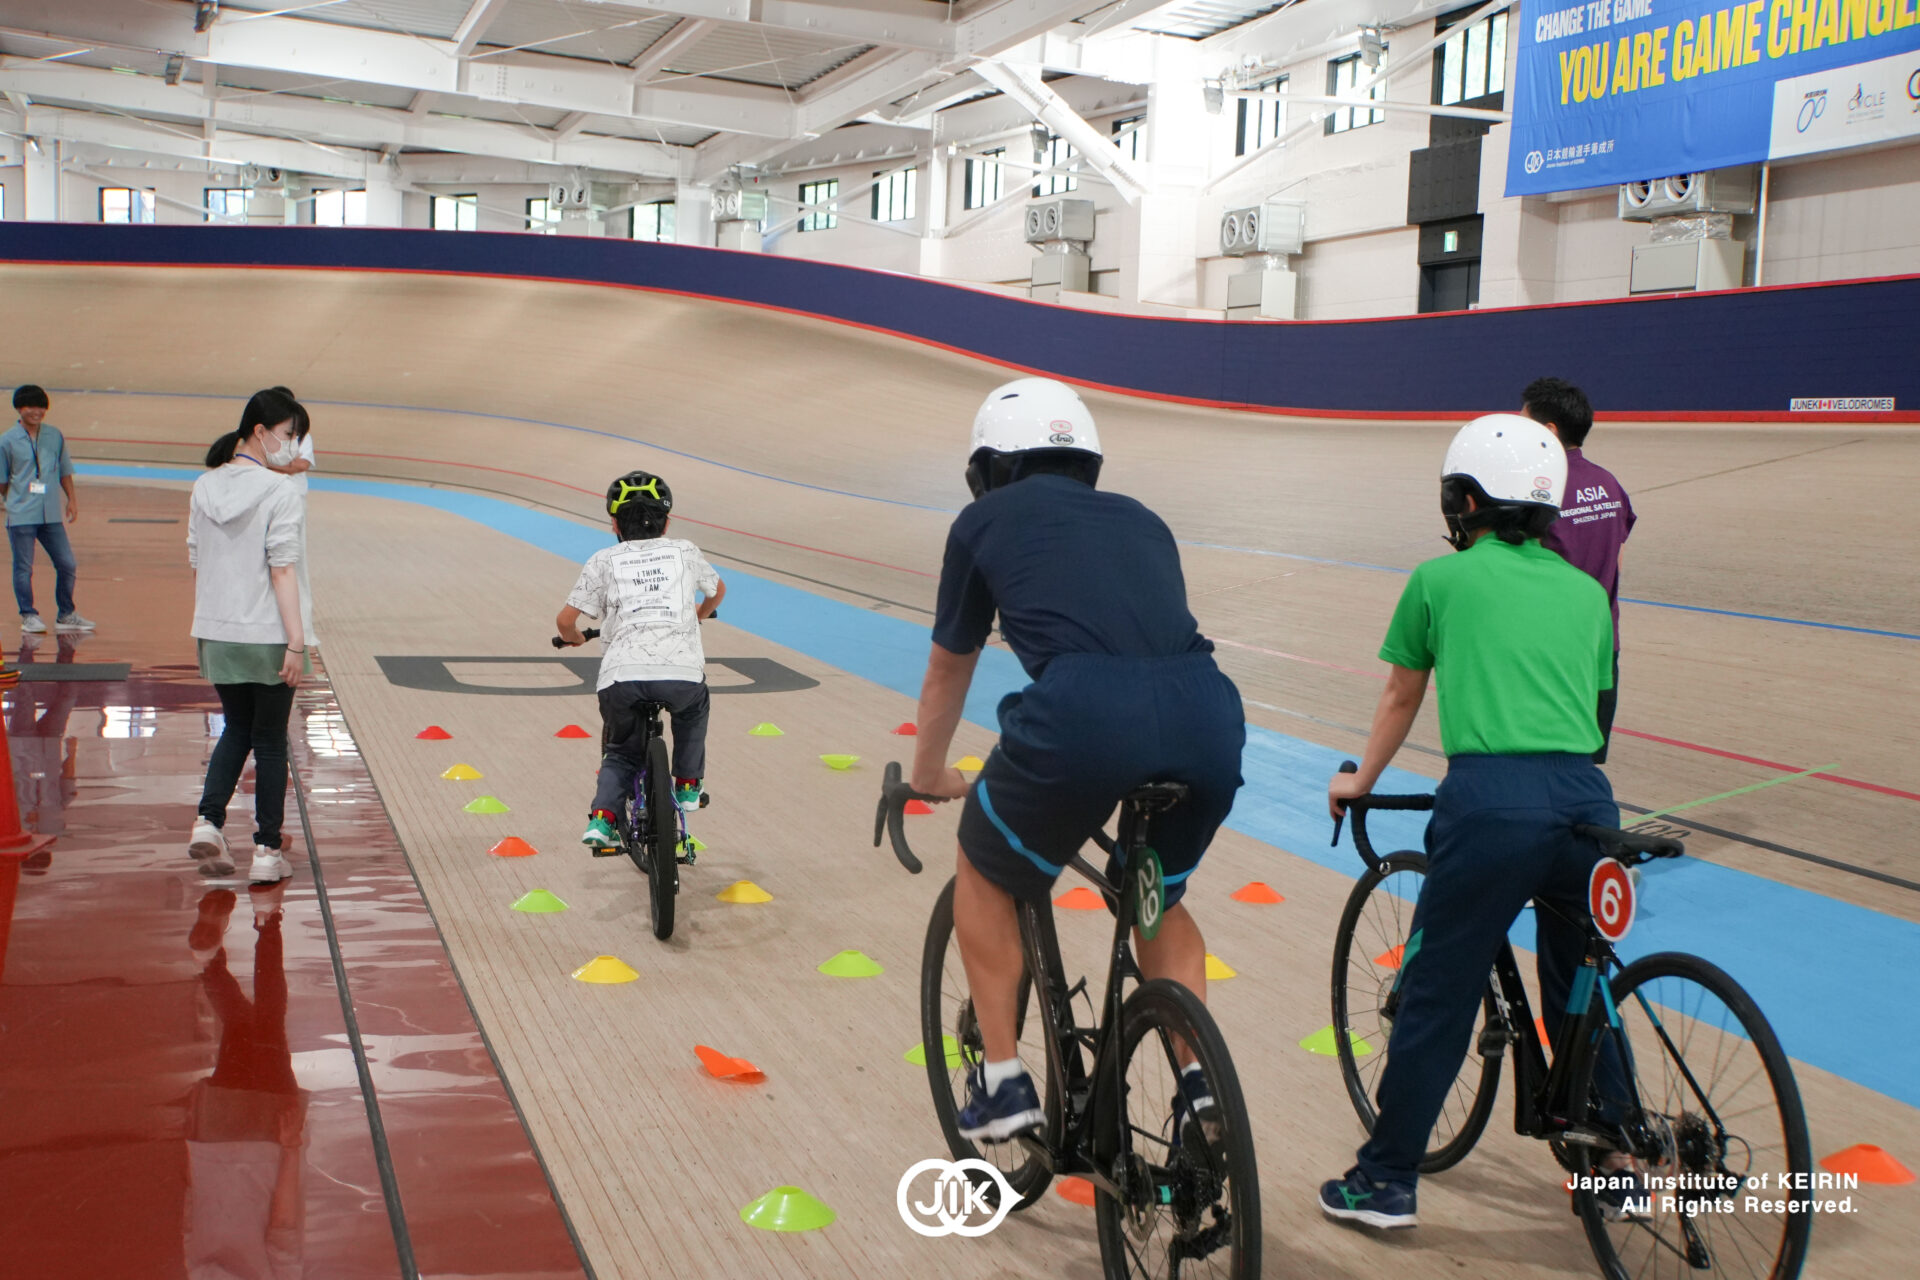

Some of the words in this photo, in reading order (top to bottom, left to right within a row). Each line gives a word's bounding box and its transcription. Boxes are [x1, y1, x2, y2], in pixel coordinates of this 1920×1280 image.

[1535, 5, 1585, 43] CHANGE
[1587, 0, 1611, 31] THE
[1613, 0, 1653, 24] GAME
[1559, 41, 1609, 105] YOU
[1611, 26, 1669, 96] ARE
[1671, 0, 1763, 82] GAME
[1792, 399, 1819, 410] JUNEK
[1832, 399, 1893, 410] VELODROMES
[1576, 485, 1609, 503] ASIA
[1560, 506, 1593, 518] REGIONAL
[1601, 878, 1622, 925] 6
